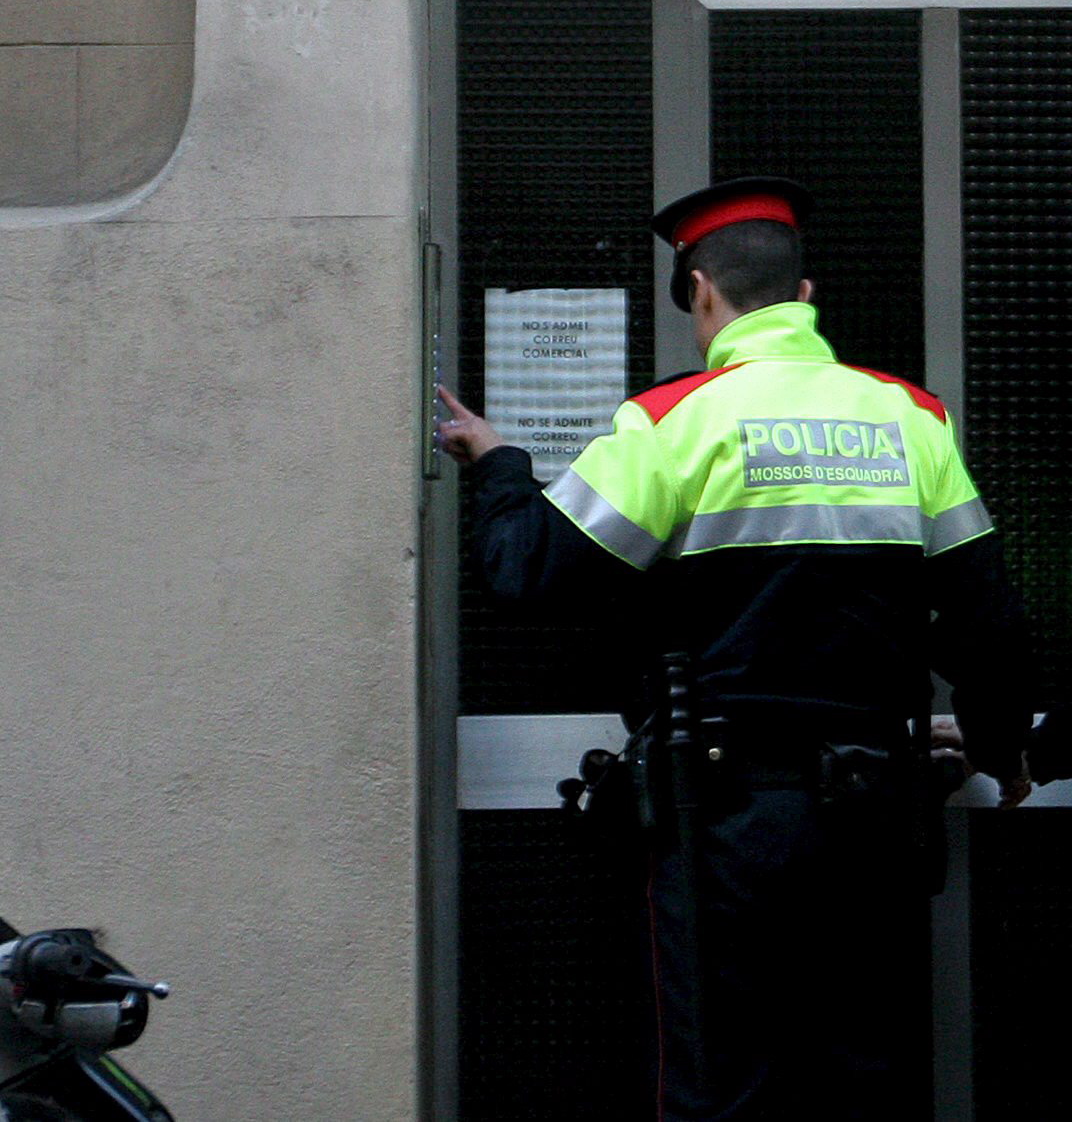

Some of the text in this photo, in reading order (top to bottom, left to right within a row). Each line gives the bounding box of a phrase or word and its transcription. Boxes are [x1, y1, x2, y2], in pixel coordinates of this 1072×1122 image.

[522, 321, 540, 331] NO
[533, 335, 577, 344] CORREU
[522, 348, 589, 358] COMERCIAL
[517, 418, 593, 428] NO SE ADMITE
[532, 432, 578, 442] CORREO
[744, 421, 900, 460] POLICIA
[524, 445, 586, 455] COMERCIA
[750, 465, 904, 483] MOSSOS D'ESQUADRA
